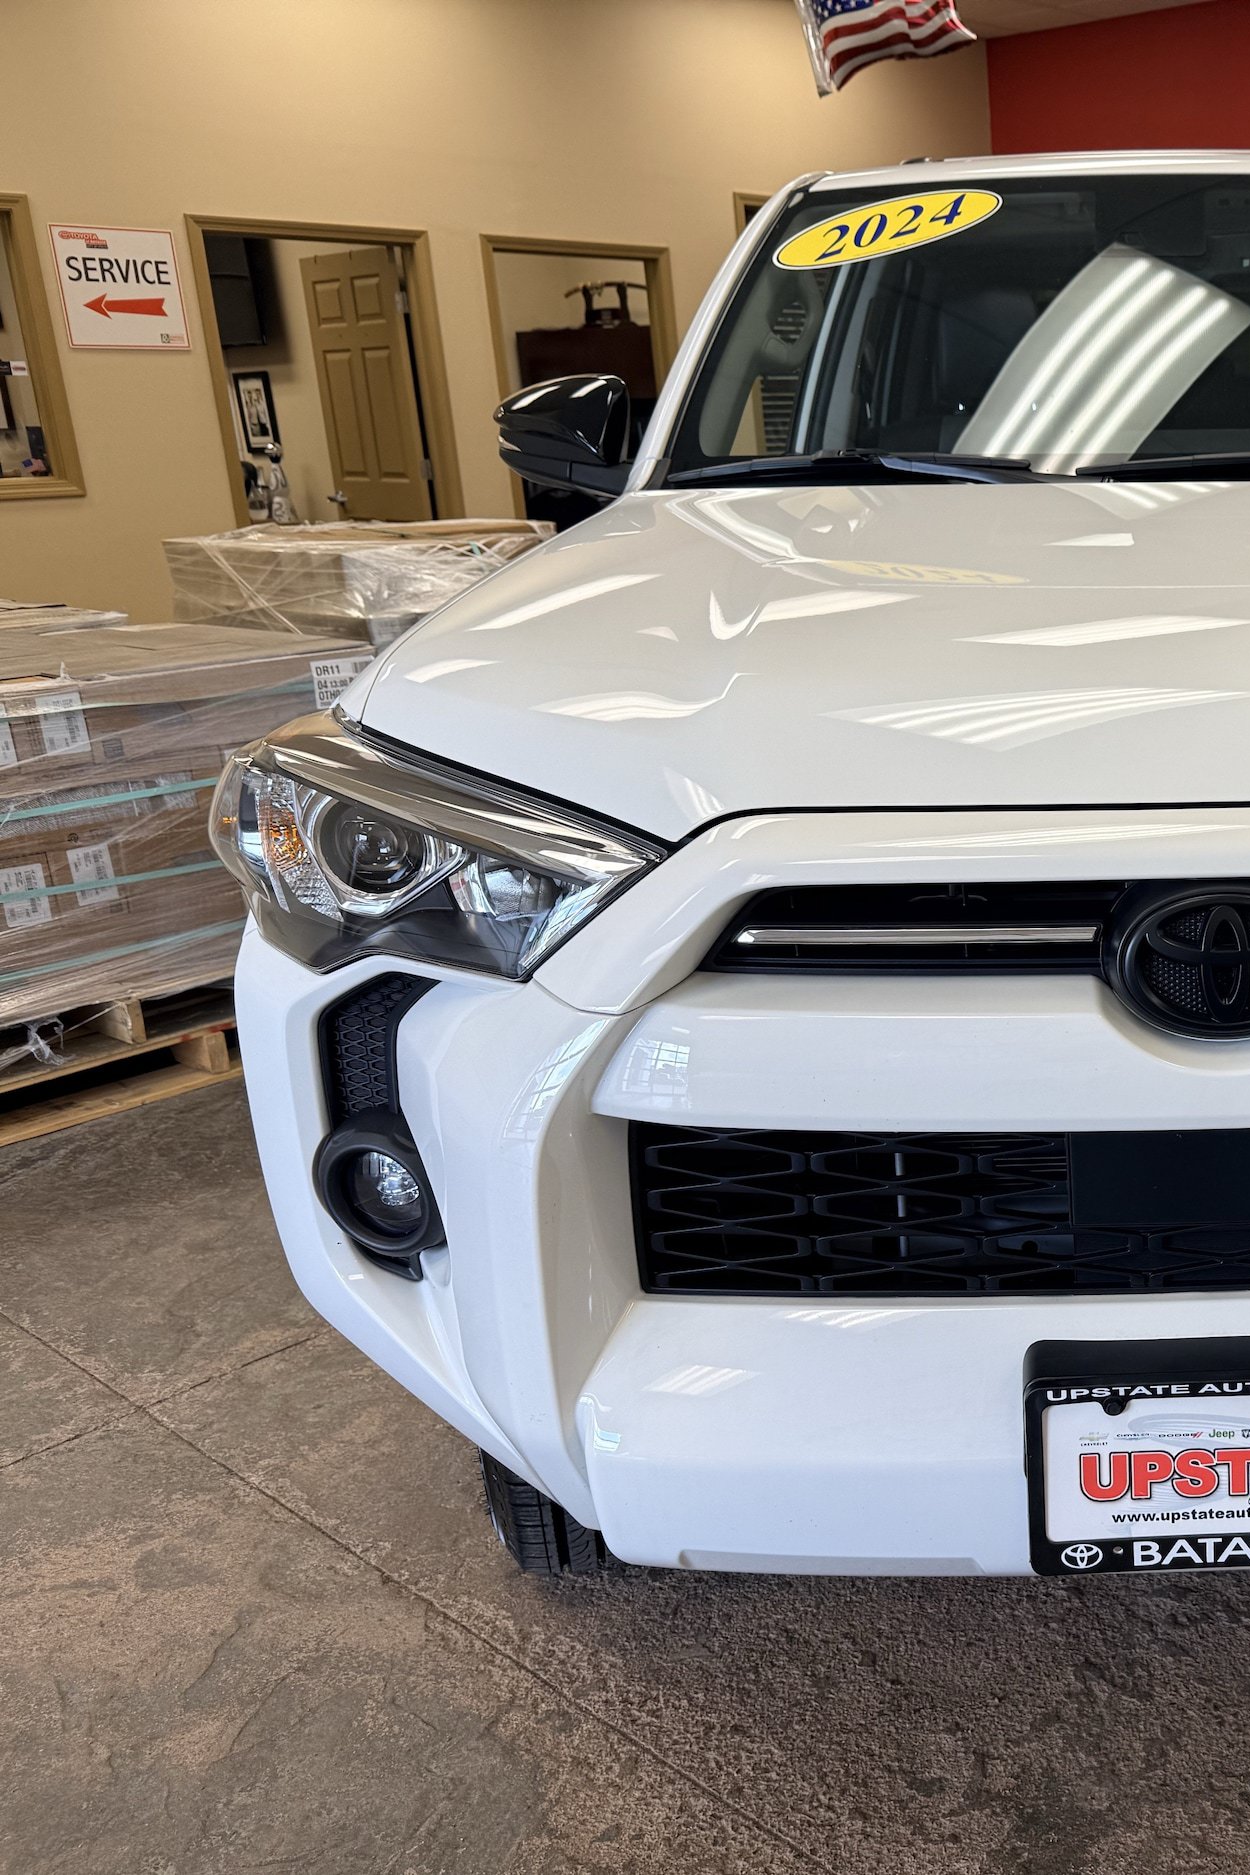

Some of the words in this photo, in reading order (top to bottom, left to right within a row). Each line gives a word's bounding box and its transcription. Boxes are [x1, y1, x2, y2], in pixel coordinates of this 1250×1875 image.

[814, 193, 967, 262] 2024
[70, 231, 99, 240] TOYOTA
[65, 256, 171, 285] SERVICE
[315, 665, 341, 677] DR11
[317, 680, 328, 690] 04
[1046, 1384, 1190, 1401] UPSTATE
[1208, 1428, 1235, 1439] Jeep
